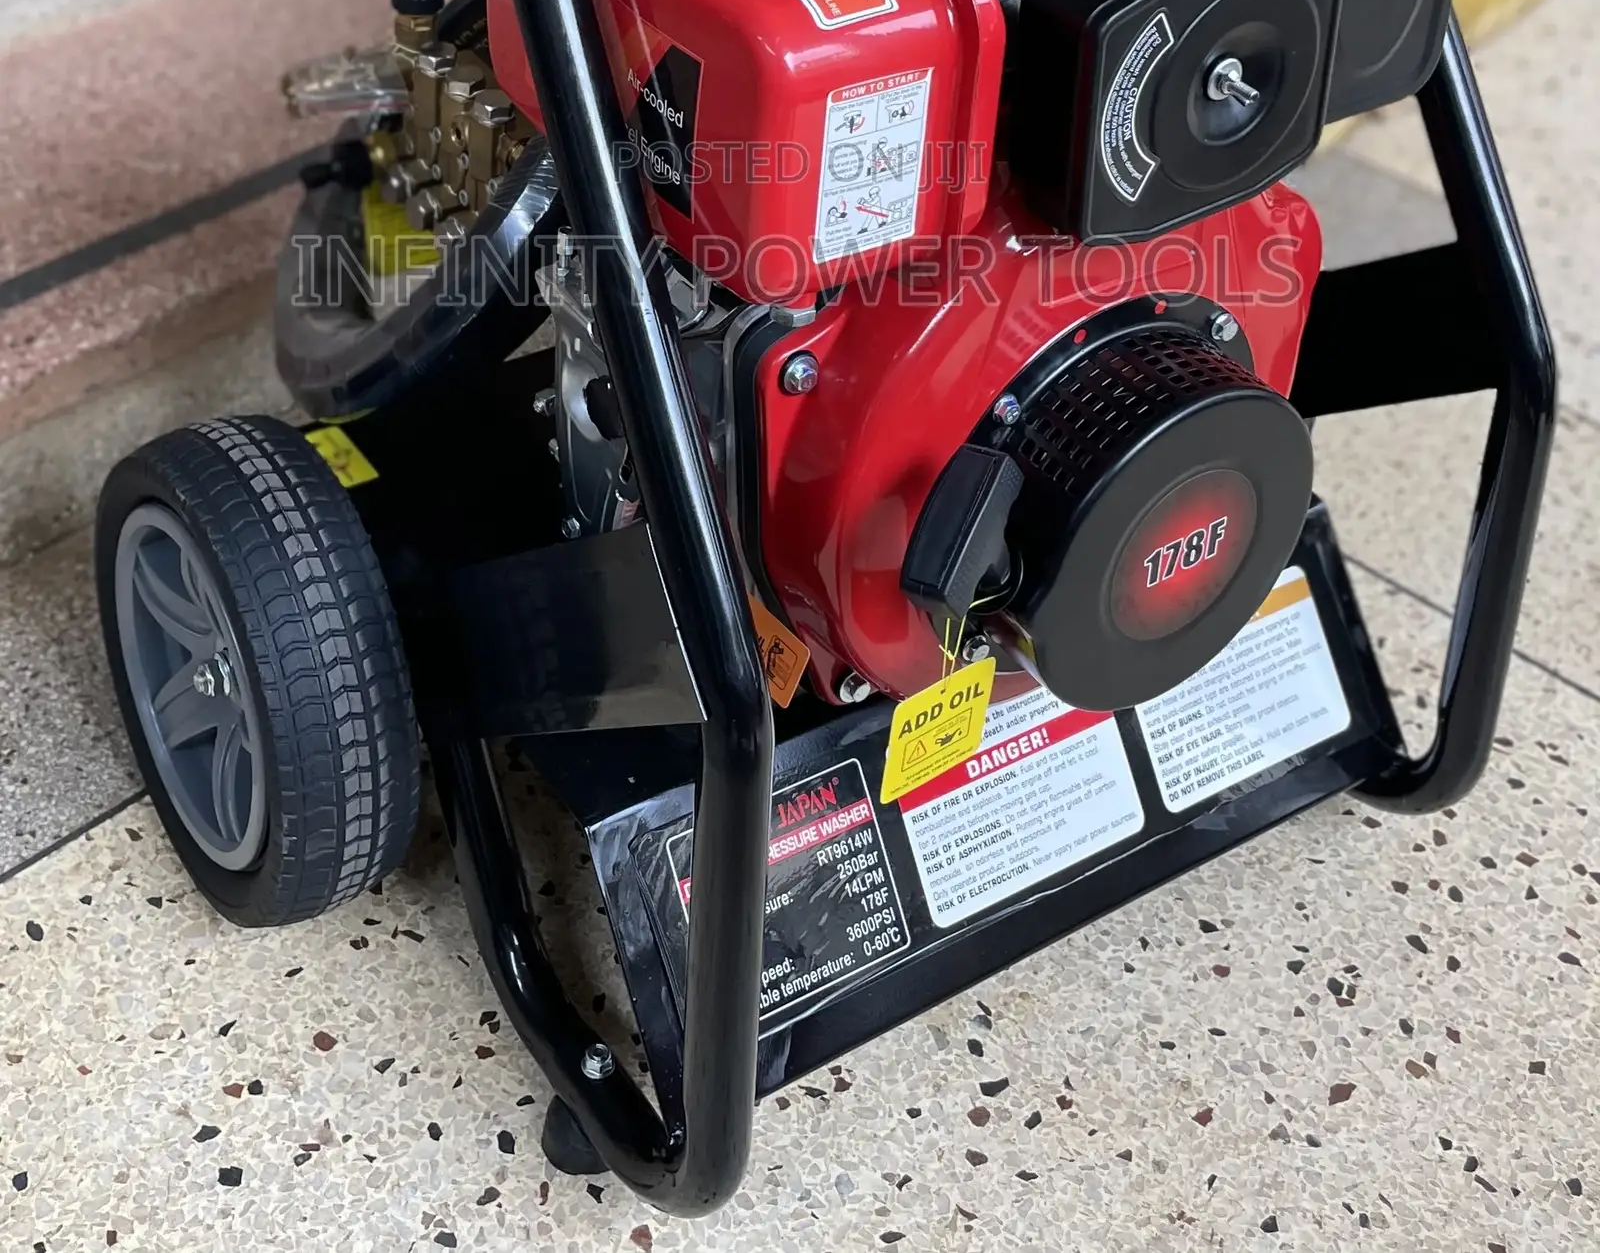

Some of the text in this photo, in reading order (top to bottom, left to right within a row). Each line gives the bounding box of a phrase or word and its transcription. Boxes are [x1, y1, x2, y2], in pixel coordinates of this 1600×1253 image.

[1144, 47, 1153, 58] not
[1152, 37, 1162, 47] Do
[1133, 59, 1146, 76] wash
[628, 68, 684, 128] Air-cooled
[842, 86, 867, 99] HOW
[869, 82, 884, 93] TO
[888, 72, 920, 86] START
[1123, 88, 1137, 140] CAUTION
[640, 136, 681, 185] Engine
[1144, 516, 1228, 588] 178F
[898, 702, 943, 740] ADD
[950, 682, 984, 710] OIL
[991, 690, 1045, 720] the instruction
[1004, 712, 1028, 729] and/or
[1028, 699, 1060, 720] property
[1149, 725, 1167, 740] RISK
[1166, 721, 1177, 732] OF
[965, 727, 1049, 778] DANGER!
[1156, 750, 1174, 765] RISK
[1173, 745, 1185, 757] OF
[1184, 738, 1200, 751] EYE
[910, 809, 930, 824] RISK
[930, 803, 942, 815] OF
[942, 795, 960, 809] FIRE
[961, 789, 973, 801] OR
[974, 768, 1019, 795] EXPLOSION.
[1164, 775, 1182, 790] RISK
[1181, 769, 1193, 781] OF
[1168, 790, 1180, 802] DO
[1179, 782, 1196, 796] NOT
[1195, 767, 1225, 788] REMOVE
[1225, 759, 1242, 774] THIS
[768, 802, 870, 861] RESSURE WASHER
[816, 828, 874, 867] RT9614W
[922, 847, 941, 862] RISK
[941, 841, 952, 853] OF
[1004, 811, 1015, 824] Do
[930, 834, 937, 844] 2
[937, 821, 966, 841] minutes
[765, 848, 880, 915] sure: 250Bar
[925, 860, 944, 875] RISK
[945, 854, 956, 866] OF
[844, 867, 885, 898] 14LPM
[860, 886, 890, 913] 178F
[936, 898, 955, 914] RISK
[956, 892, 967, 904] OF
[761, 905, 896, 988] peed: 3600PSI
[783, 949, 855, 1001] temperature:
